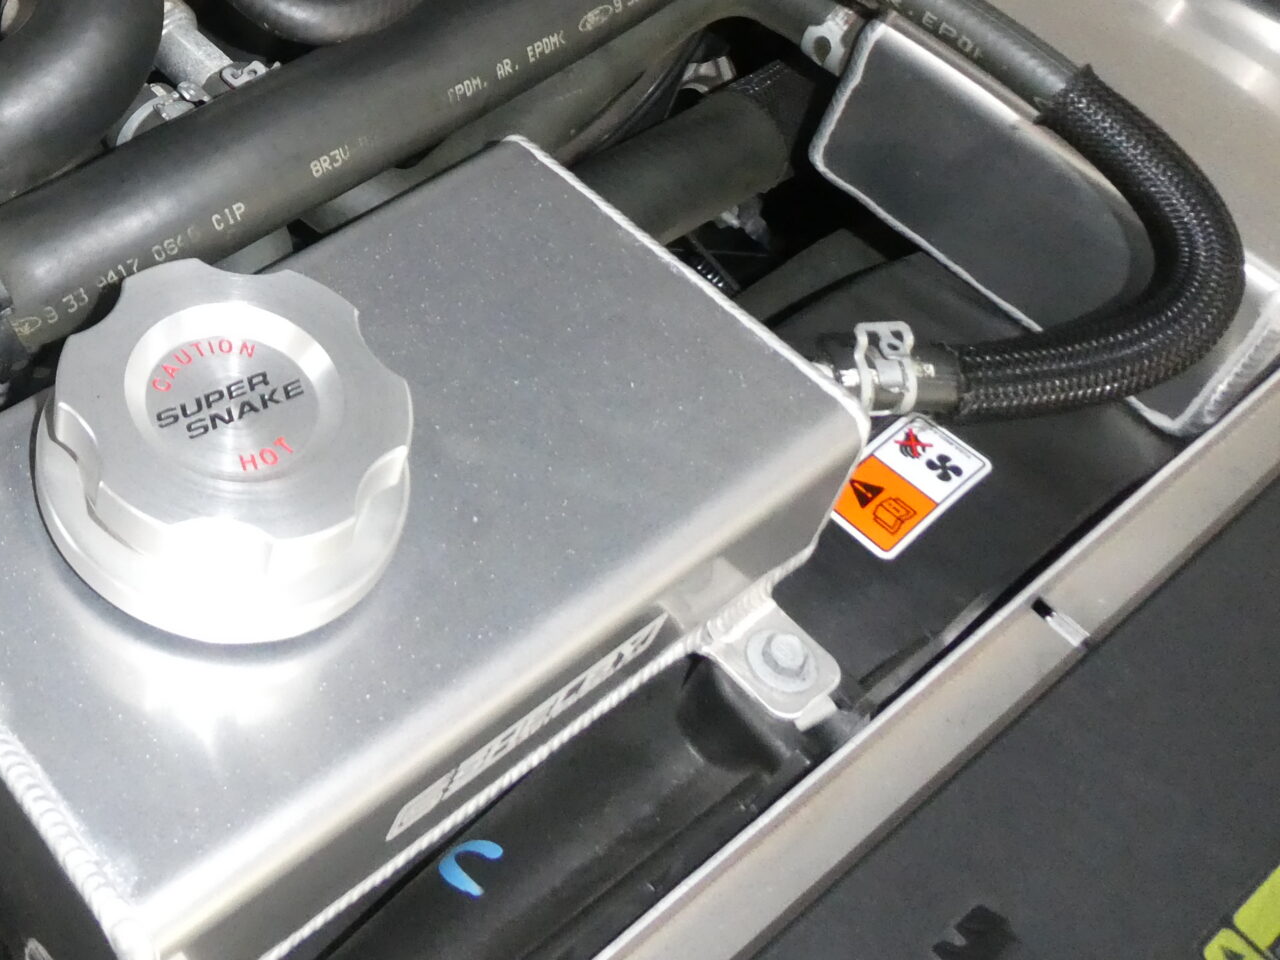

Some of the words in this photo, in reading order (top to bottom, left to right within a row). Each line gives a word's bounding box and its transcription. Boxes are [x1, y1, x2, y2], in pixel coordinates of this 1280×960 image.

[211, 201, 247, 233] CIP
[151, 338, 257, 393] CAUTION
[156, 371, 270, 429] SUPER
[186, 378, 305, 440] SNAKE
[238, 436, 295, 472] HOT
